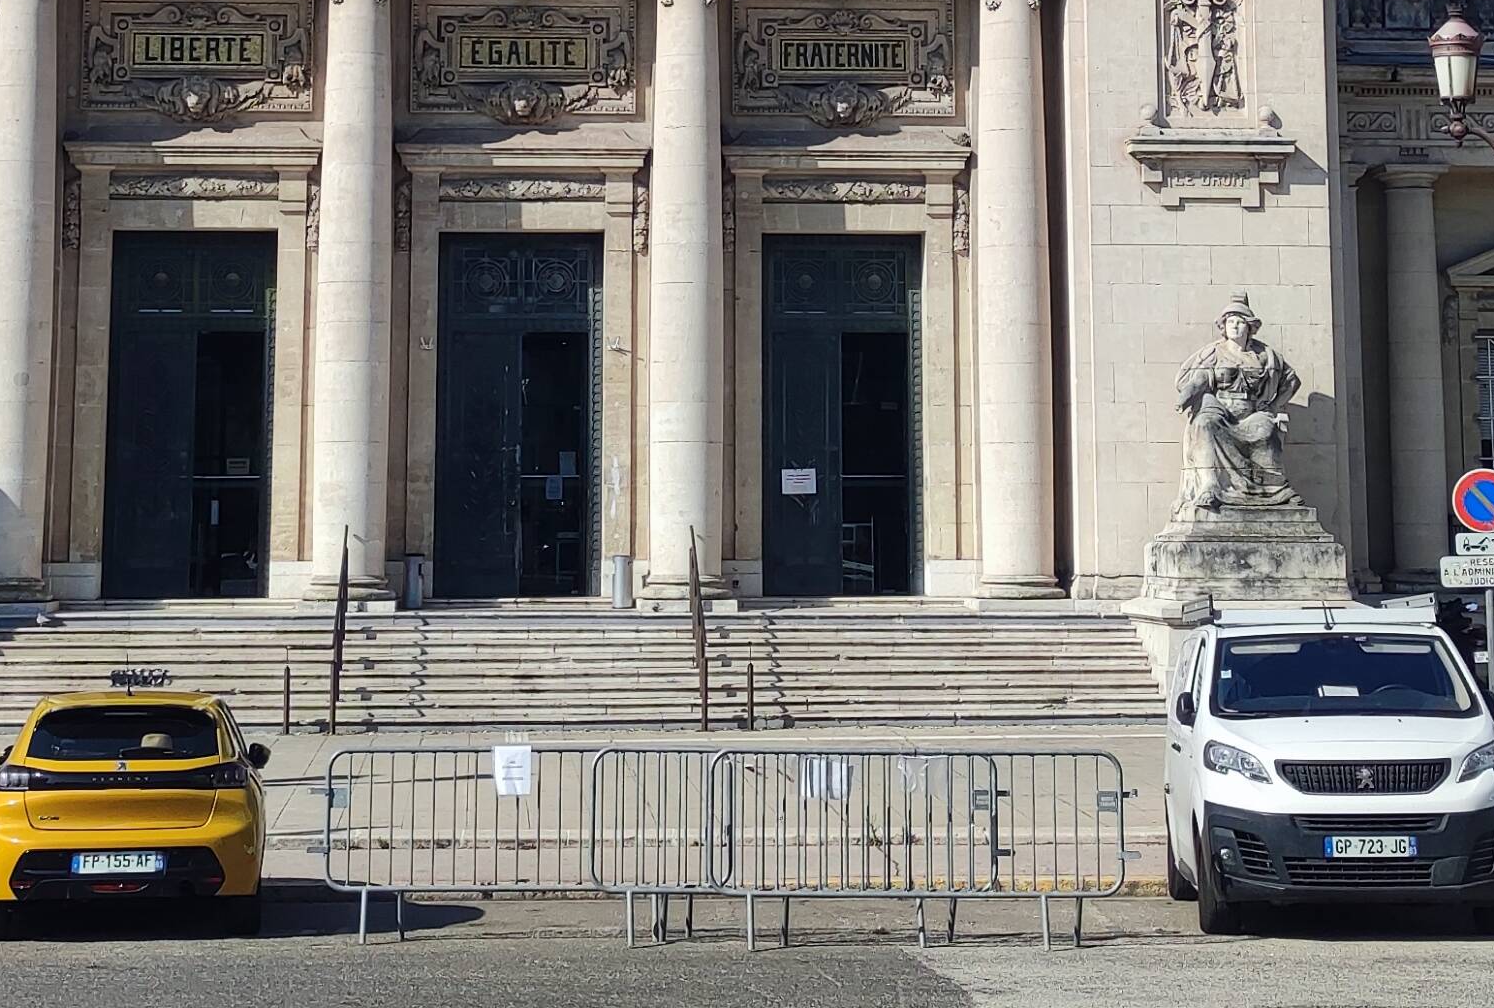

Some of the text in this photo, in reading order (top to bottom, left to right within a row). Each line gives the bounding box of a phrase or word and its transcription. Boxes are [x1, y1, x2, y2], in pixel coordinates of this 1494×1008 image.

[144, 34, 253, 62] LIBERTÉ
[471, 38, 577, 66] ÉGALITÉ
[783, 41, 903, 68] FRATERNITÉ
[1174, 171, 1247, 188] LE DROIT
